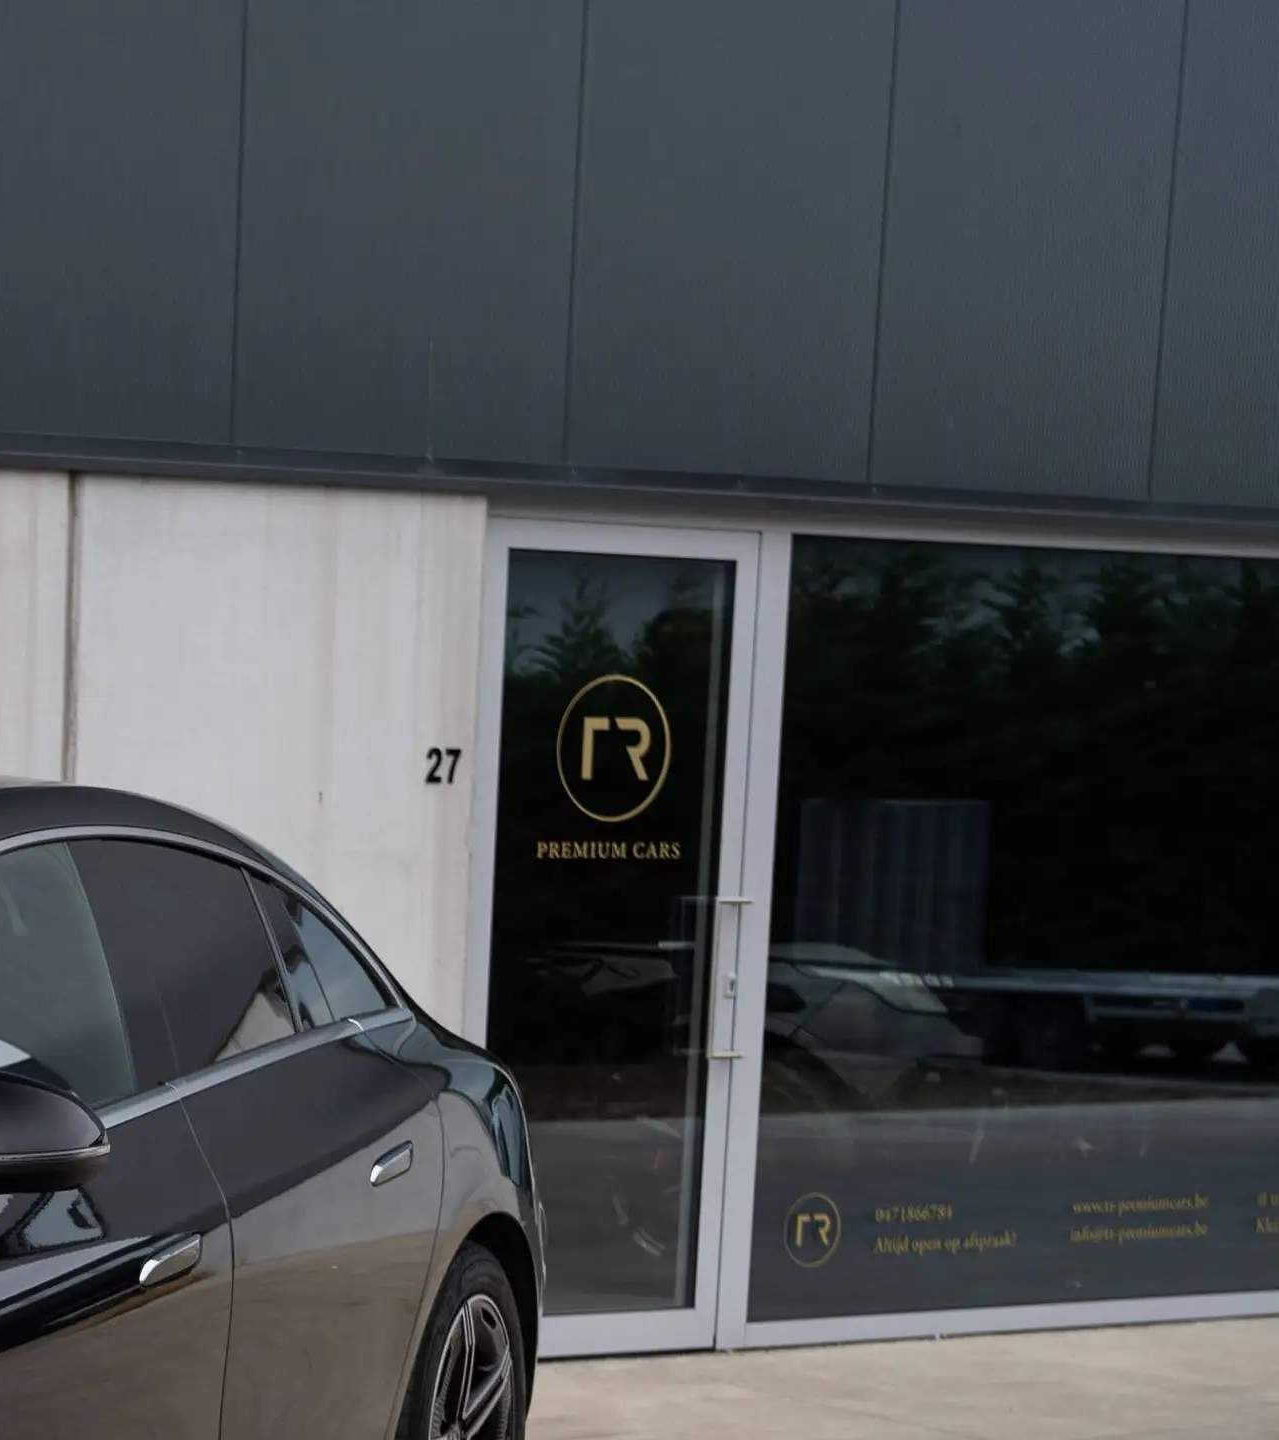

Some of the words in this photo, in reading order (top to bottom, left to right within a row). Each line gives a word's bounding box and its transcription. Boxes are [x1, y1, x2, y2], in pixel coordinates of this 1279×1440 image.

[424, 747, 463, 785] 27
[536, 841, 628, 860] PREMIUM
[632, 840, 682, 860] CARS
[911, 1238, 942, 1255] open
